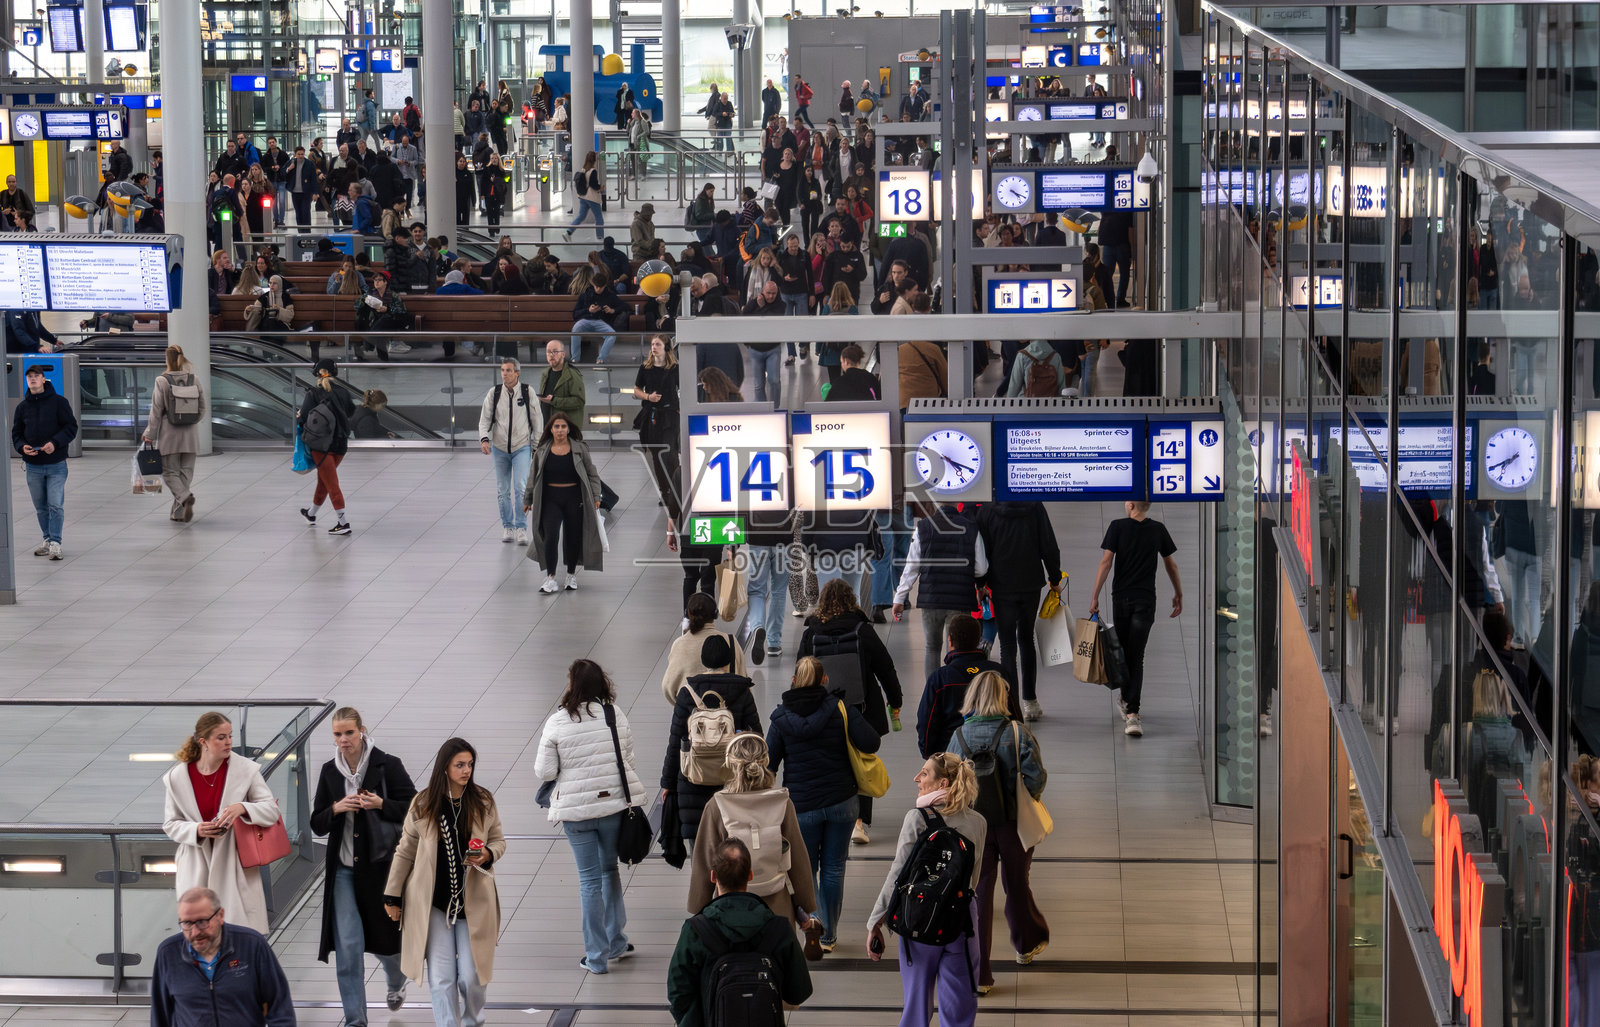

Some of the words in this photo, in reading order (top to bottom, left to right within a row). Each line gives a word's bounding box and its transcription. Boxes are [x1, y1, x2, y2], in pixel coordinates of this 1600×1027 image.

[27, 33, 37, 45] D
[349, 57, 360, 71] C
[1054, 52, 1066, 67] C
[888, 189, 922, 215] 18
[711, 424, 742, 434] spoor
[815, 422, 845, 432] spoor
[1156, 441, 1184, 456] 14a
[707, 451, 778, 502] 14
[810, 448, 874, 500] 15
[1156, 475, 1184, 491] 15a
